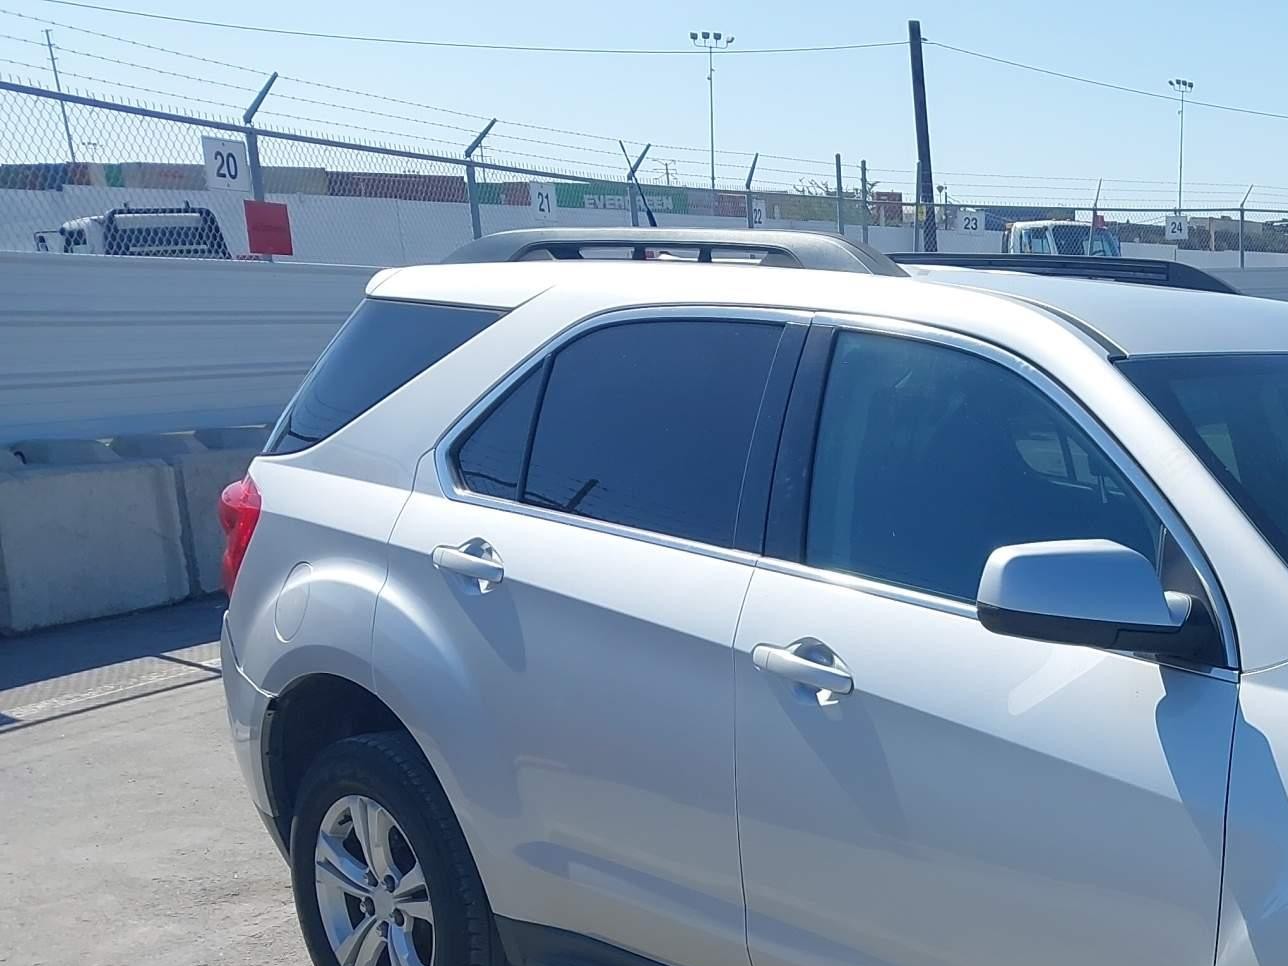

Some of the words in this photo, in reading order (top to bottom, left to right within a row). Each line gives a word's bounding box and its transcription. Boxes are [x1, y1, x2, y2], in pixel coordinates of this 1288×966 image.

[214, 151, 238, 180] 20
[537, 192, 550, 213] 21
[753, 208, 762, 224] 22
[964, 216, 978, 230] 23
[1170, 221, 1182, 234] 24
